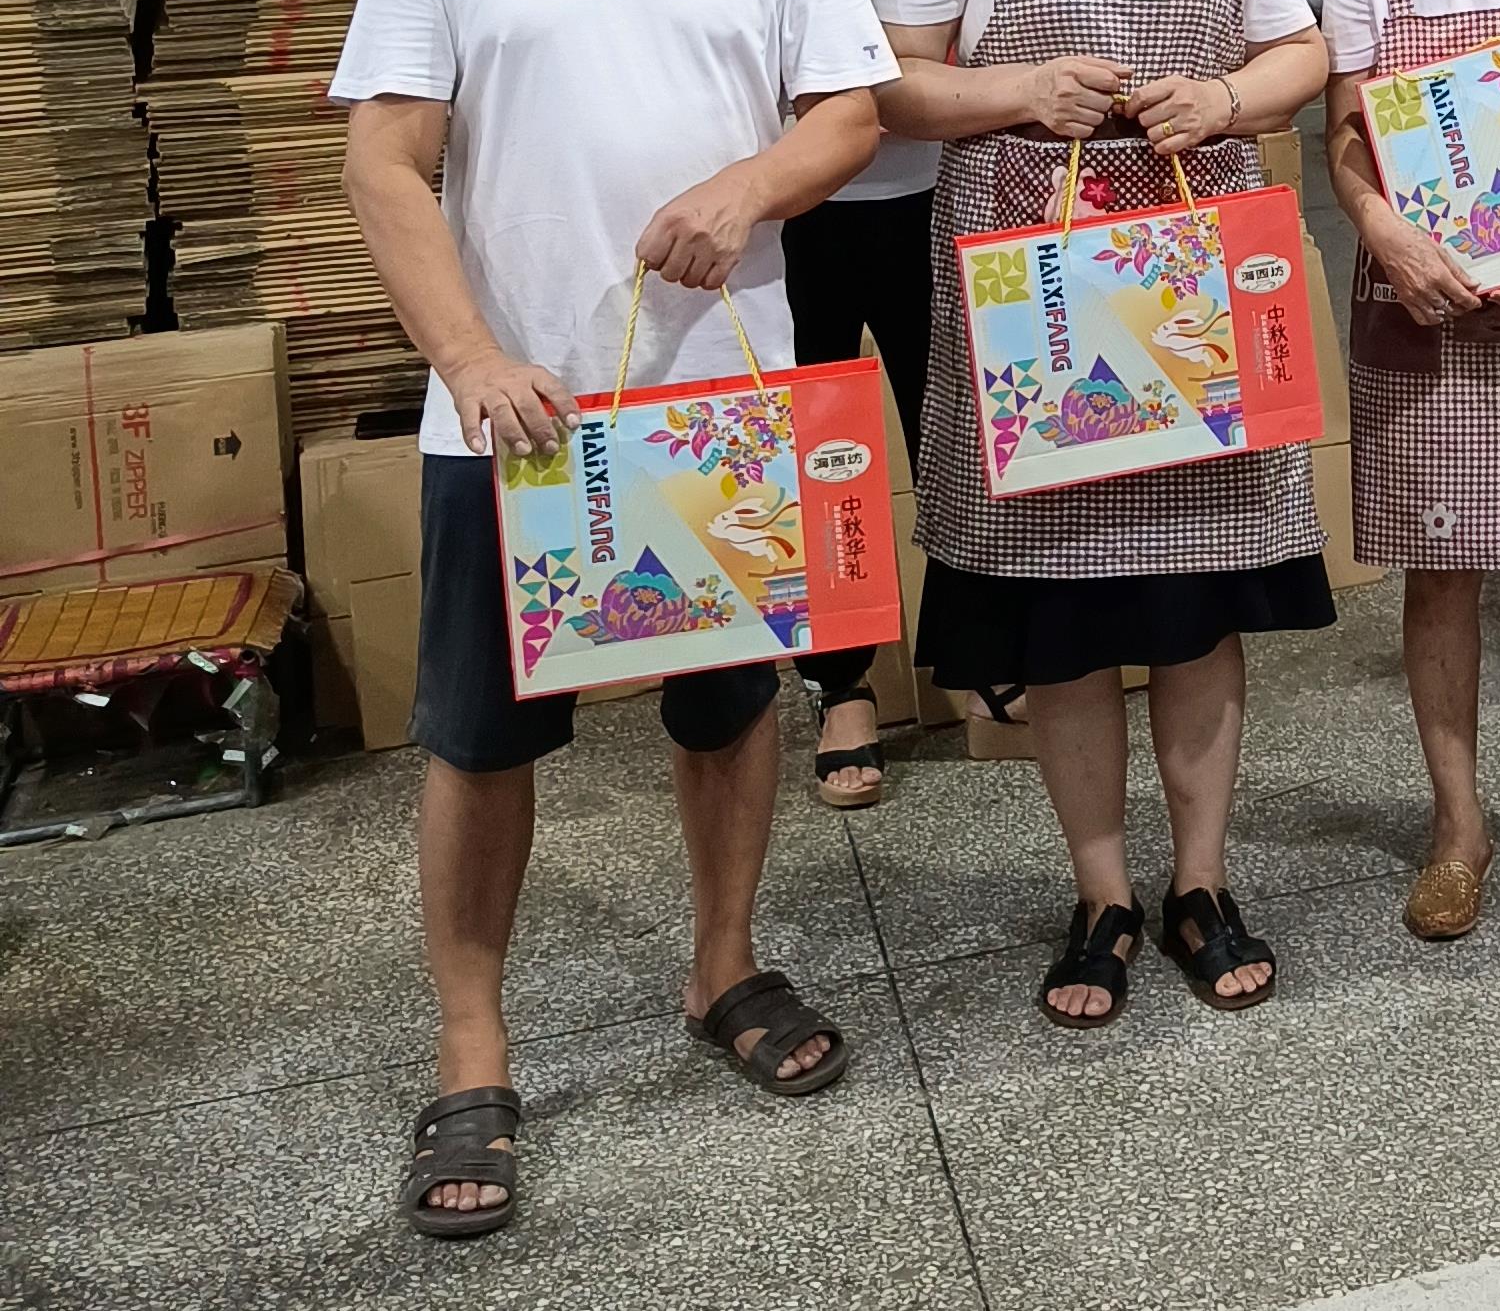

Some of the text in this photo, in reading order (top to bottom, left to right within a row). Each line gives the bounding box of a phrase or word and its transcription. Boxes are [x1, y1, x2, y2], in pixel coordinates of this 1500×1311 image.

[1267, 304, 1293, 384] 中秋华礼
[124, 448, 148, 520] ZIPPER
[841, 495, 868, 582] 中秋华礼
